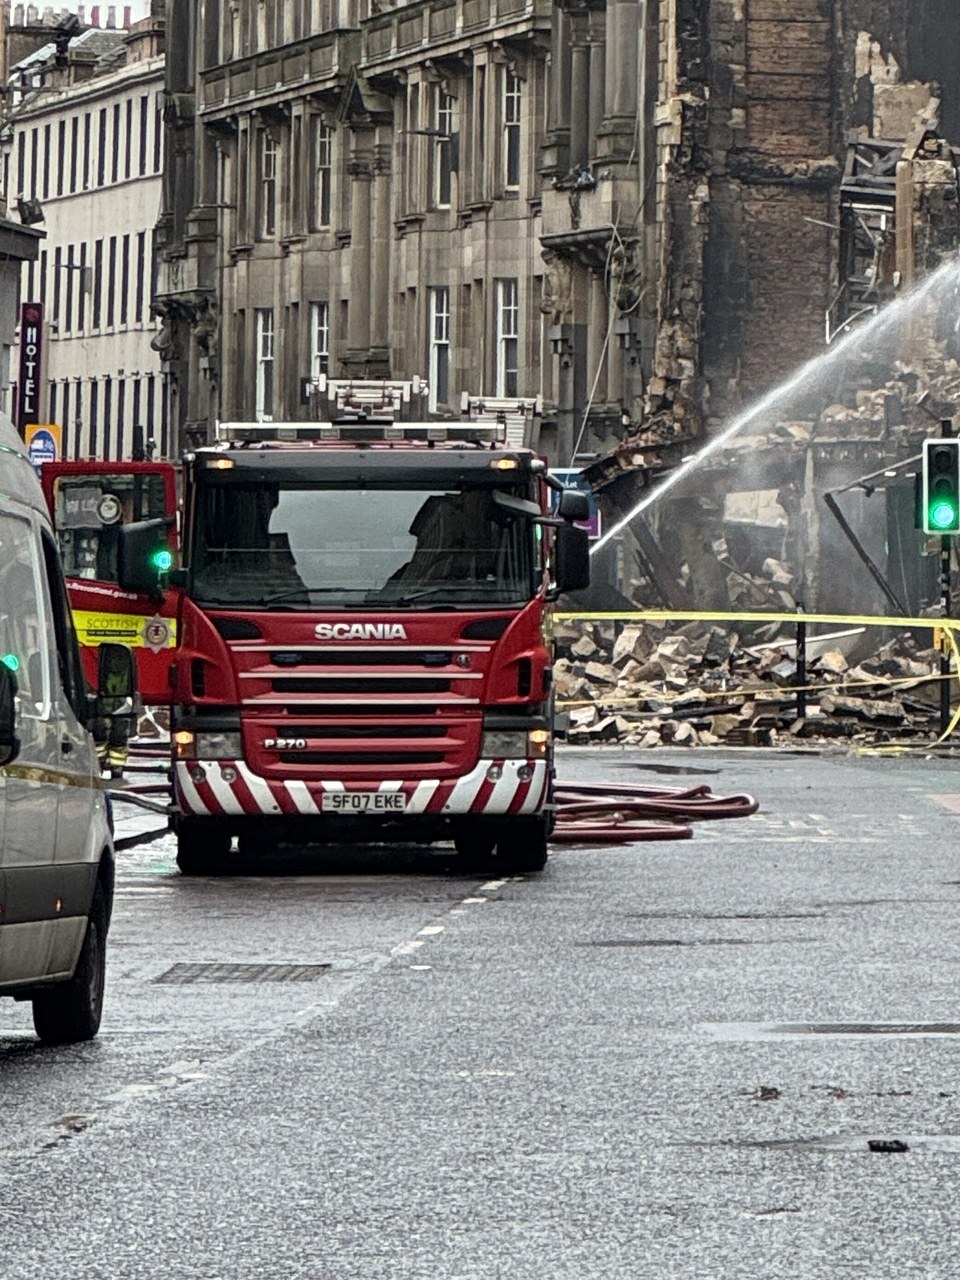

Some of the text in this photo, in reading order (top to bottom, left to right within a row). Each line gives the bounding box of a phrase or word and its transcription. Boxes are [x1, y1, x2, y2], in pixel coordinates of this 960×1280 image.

[25, 327, 36, 413] HOTEL
[87, 617, 139, 629] SCOTTISH
[314, 624, 407, 640] SCANIA
[332, 795, 404, 809] SF07 EKE
